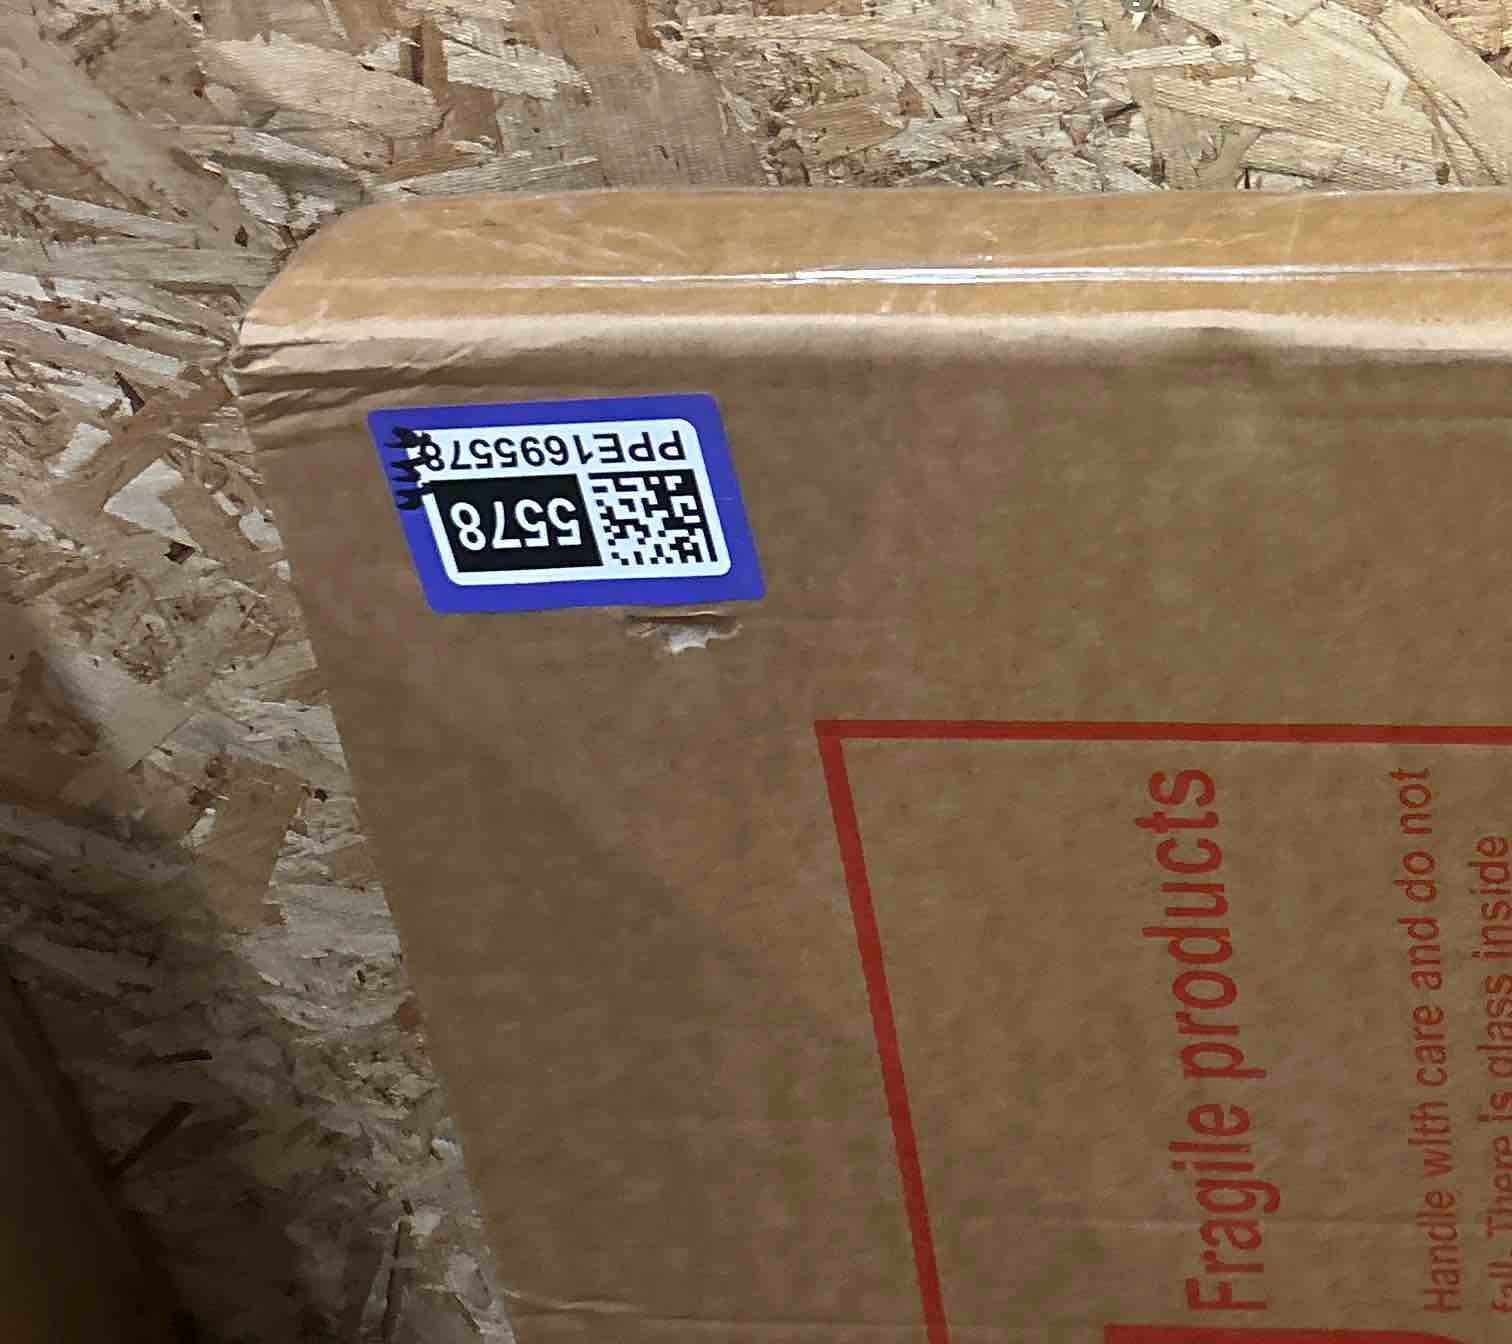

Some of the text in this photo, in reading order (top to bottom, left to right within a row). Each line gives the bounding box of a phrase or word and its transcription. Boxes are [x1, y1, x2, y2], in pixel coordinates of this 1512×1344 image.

[420, 429, 687, 473] PPE1695578
[449, 497, 582, 552] 5578
[1134, 768, 1281, 1312] Fragile products
[1389, 766, 1464, 1313] Handle with care and do not
